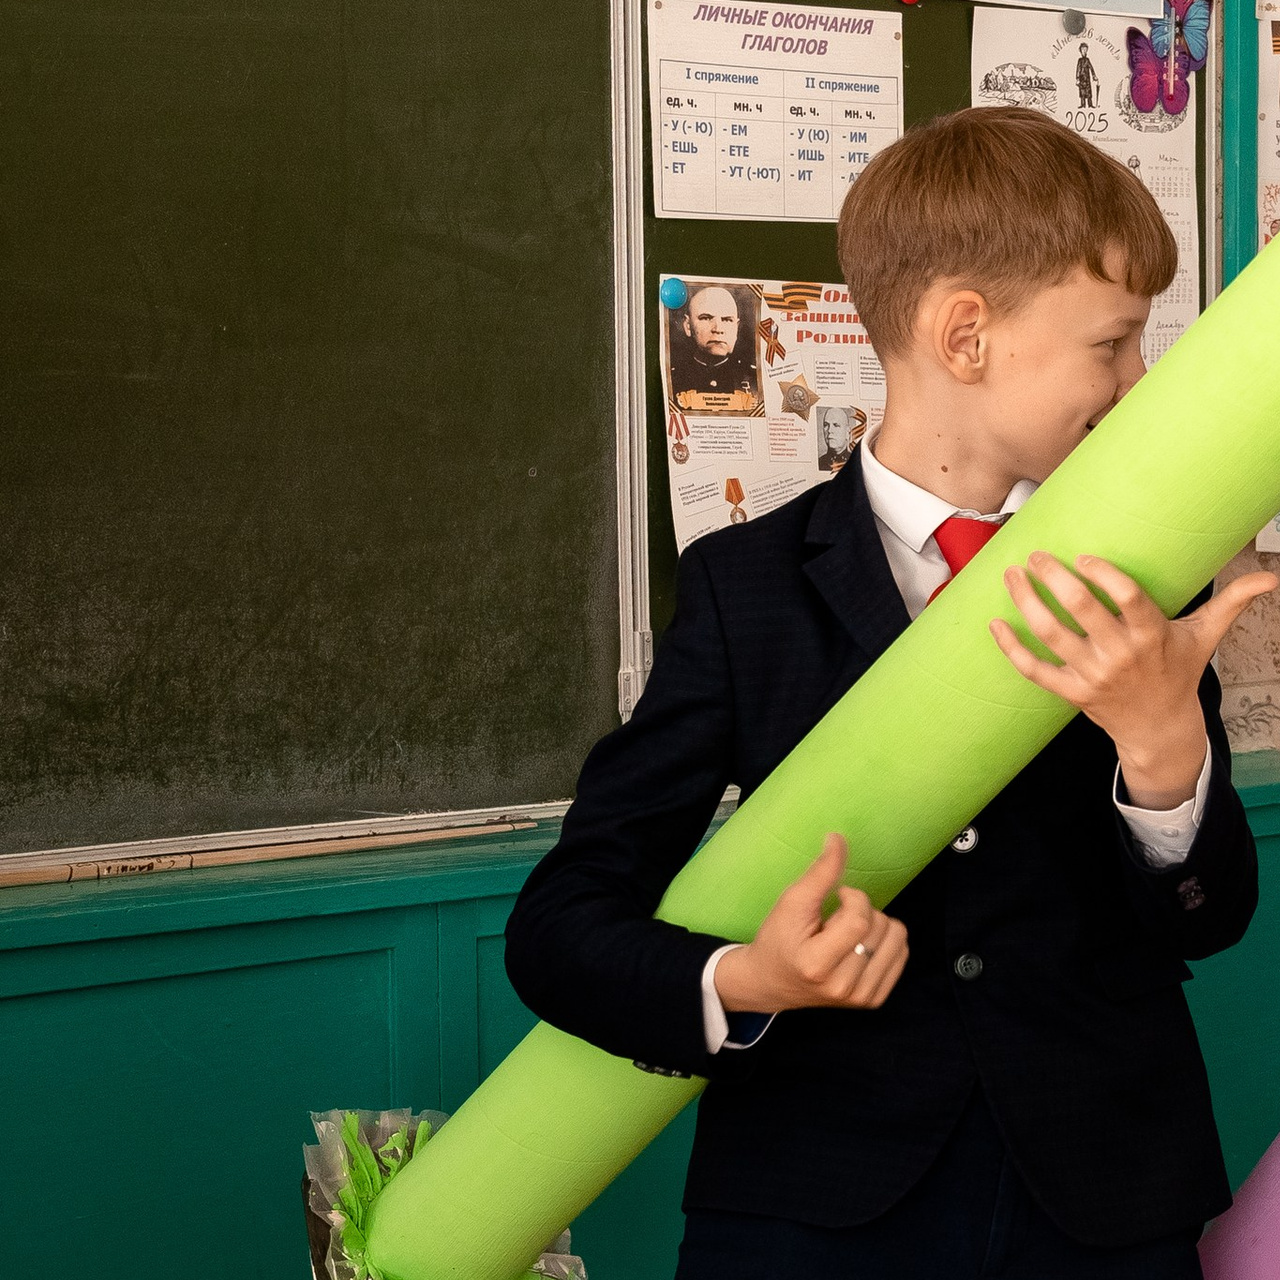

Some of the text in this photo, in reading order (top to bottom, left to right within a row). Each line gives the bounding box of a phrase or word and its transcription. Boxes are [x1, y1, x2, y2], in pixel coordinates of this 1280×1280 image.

[693, 4, 874, 35] ЛИЧНЫЕ ОКОНЧАНИЯ
[740, 33, 829, 56] ГЛАГОЛОВ
[694, 70, 759, 85] спряжение
[818, 79, 880, 93] спряжение
[666, 95, 698, 109] ед. ч.
[733, 101, 753, 113] мн.
[789, 105, 820, 118] ед. ч.
[844, 108, 876, 120] мн. ч.
[1065, 111, 1109, 133] 2025
[747, 167, 781, 184] (-ЮТ)
[796, 330, 872, 344] Родин
